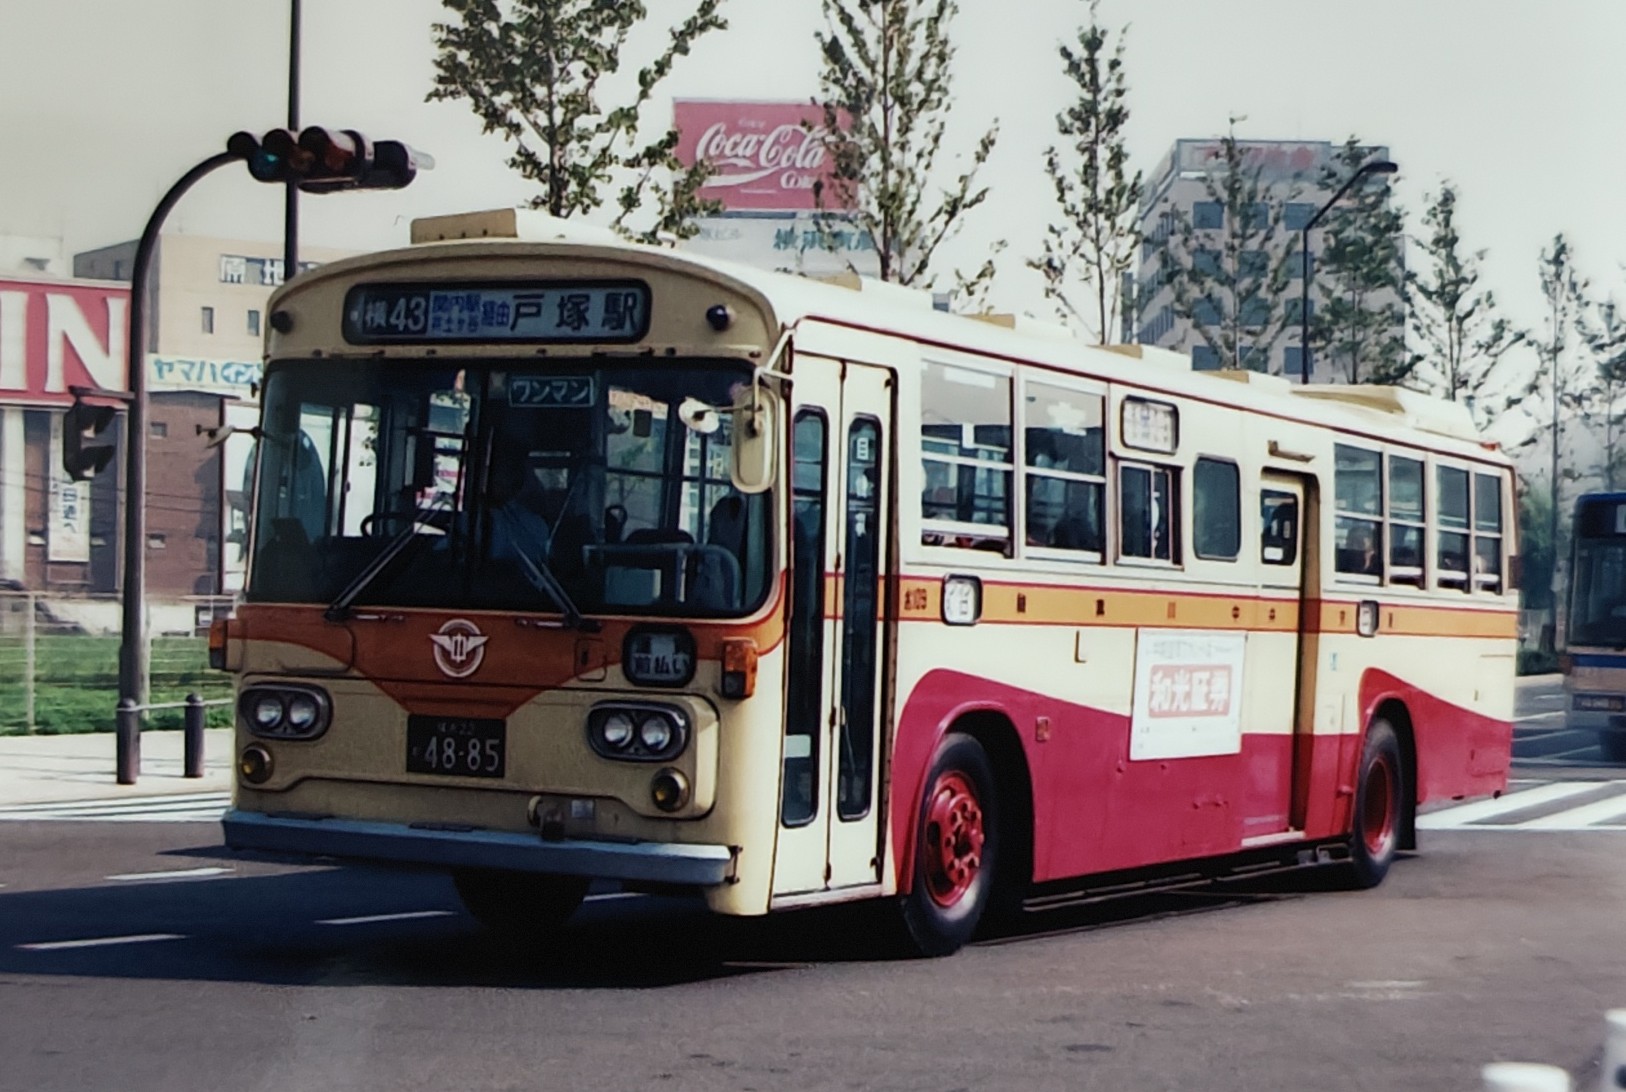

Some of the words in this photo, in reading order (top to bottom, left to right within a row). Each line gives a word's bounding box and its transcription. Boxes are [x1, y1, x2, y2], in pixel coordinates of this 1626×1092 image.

[510, 292, 638, 331] 戸塚駅
[512, 380, 589, 402] ワンマン
[424, 736, 500, 771] 48-85
